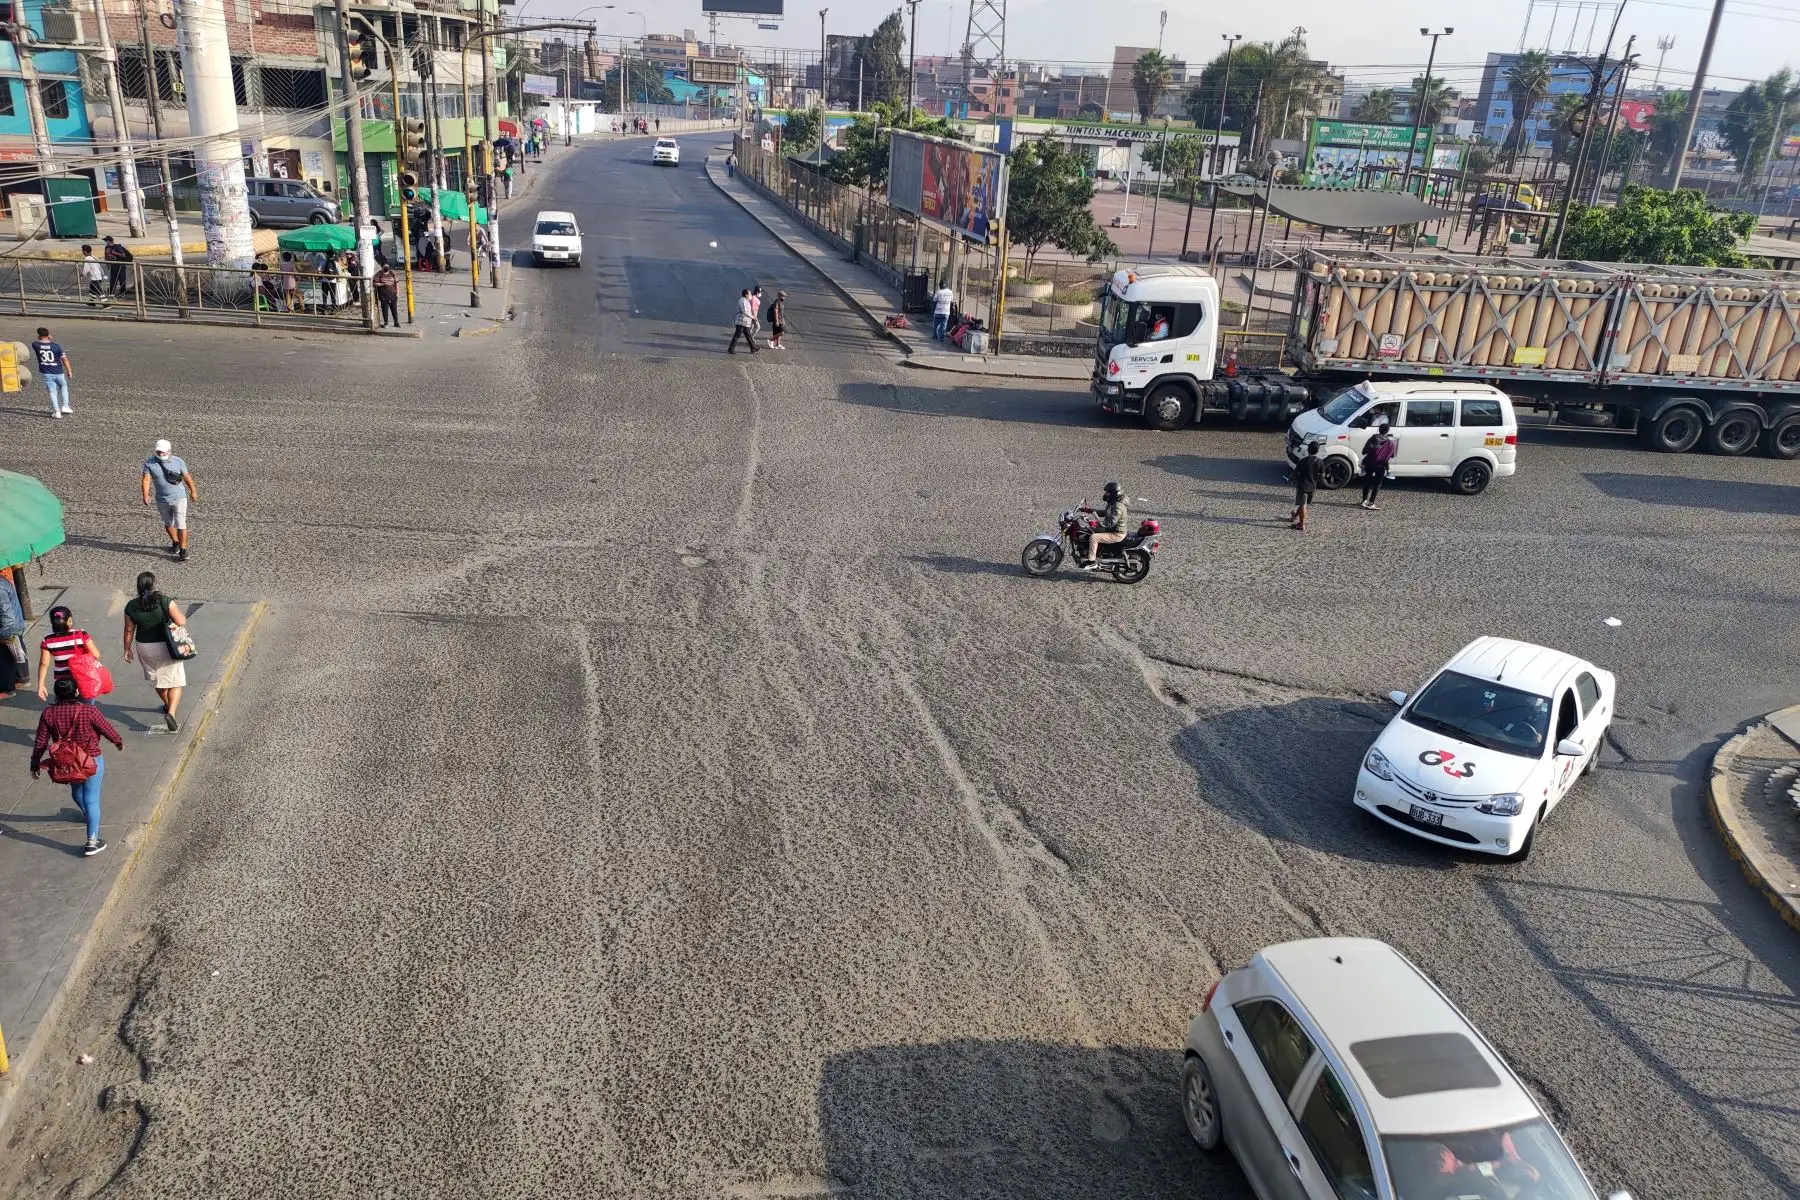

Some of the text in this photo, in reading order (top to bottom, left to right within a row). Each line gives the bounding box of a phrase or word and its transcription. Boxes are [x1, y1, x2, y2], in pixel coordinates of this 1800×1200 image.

[1066, 125, 1101, 136] JUNTOS
[1104, 128, 1152, 140] HACEMOS
[39, 350, 55, 363] 30
[1419, 750, 1476, 778] G4S
[1411, 807, 1441, 825] BUB-333
